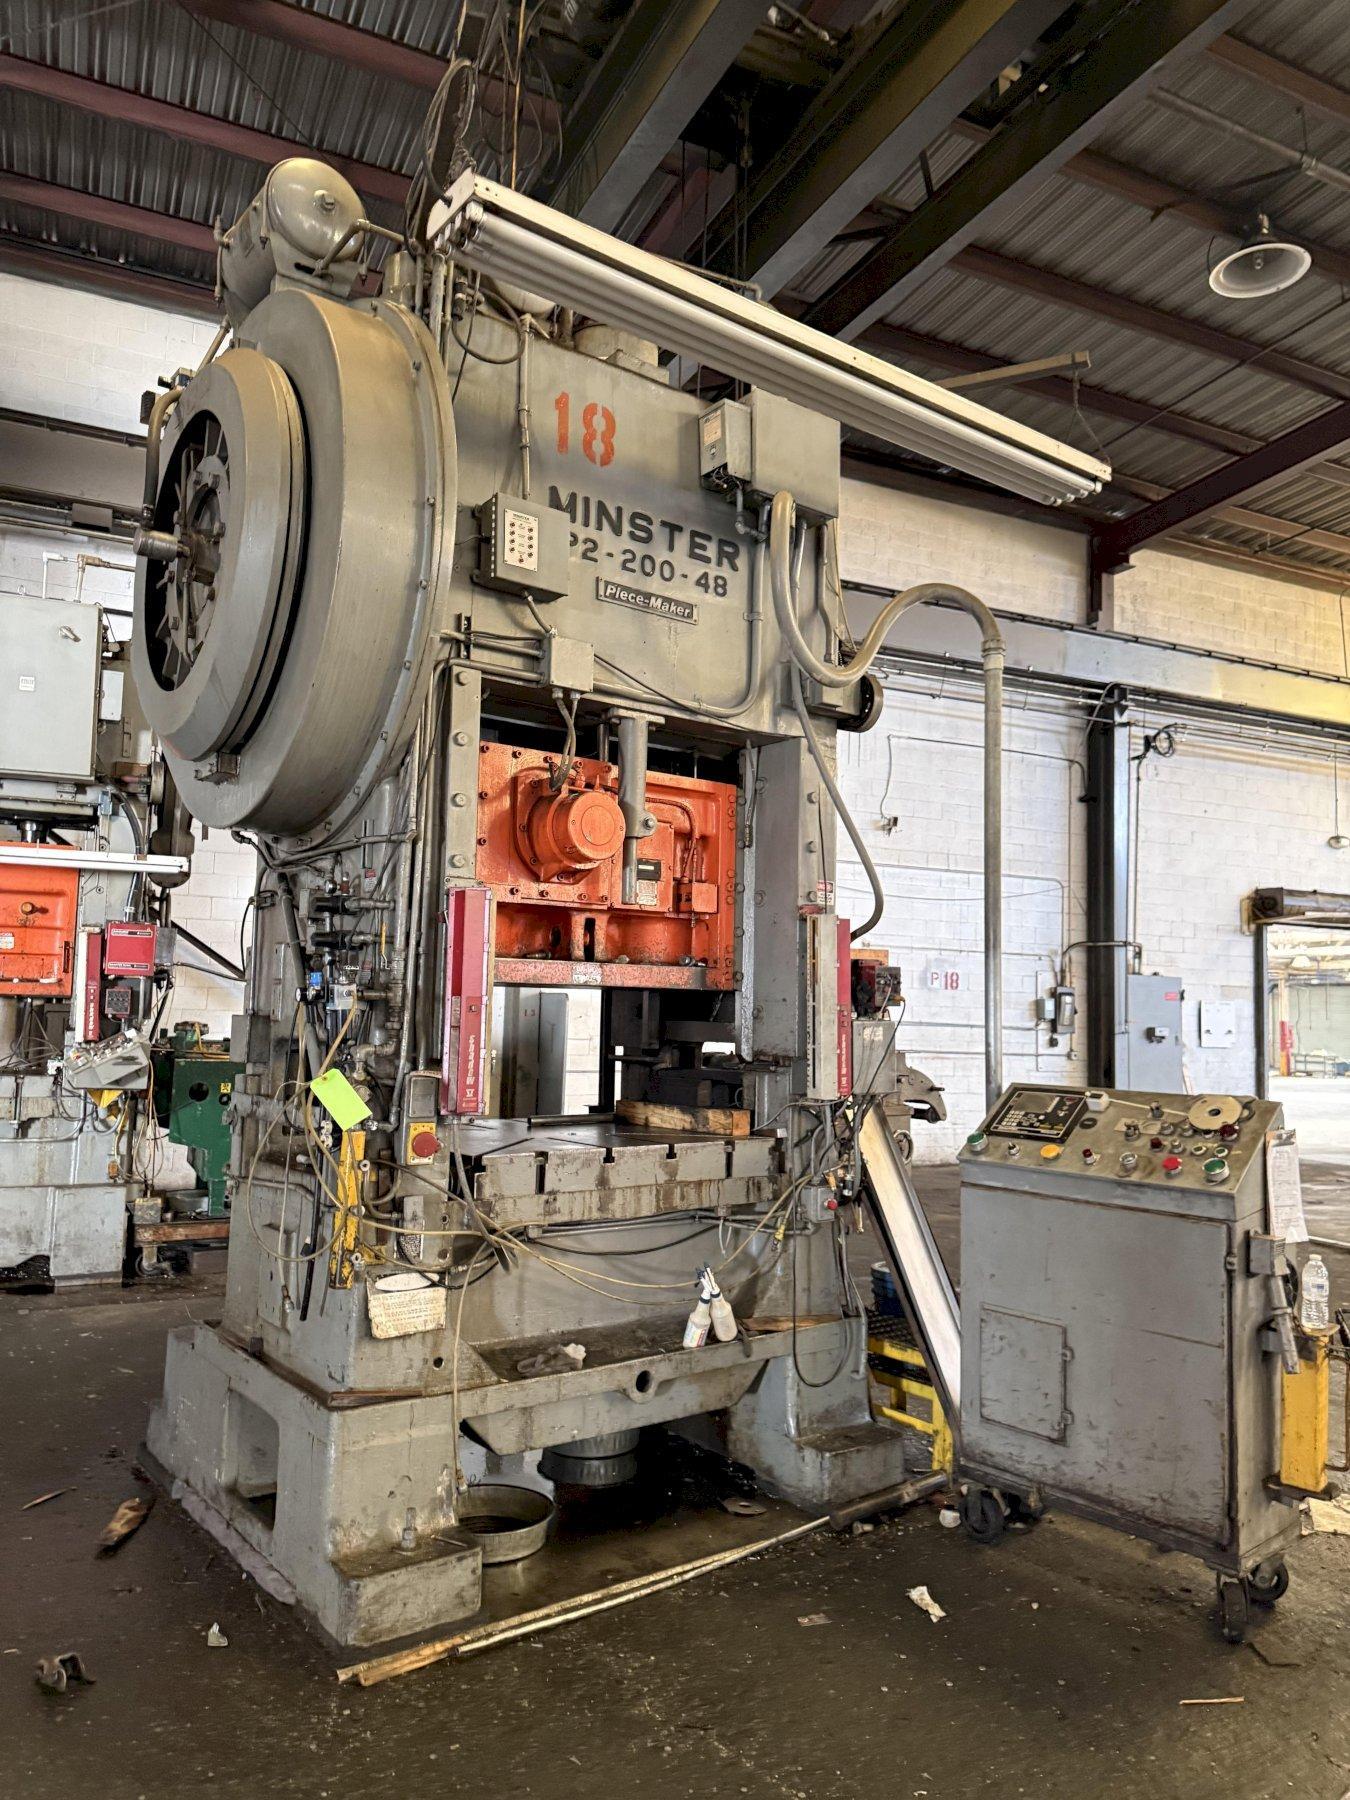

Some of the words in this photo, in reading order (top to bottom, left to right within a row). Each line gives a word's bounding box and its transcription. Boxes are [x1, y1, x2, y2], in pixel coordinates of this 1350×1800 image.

[554, 391, 616, 467] 18
[549, 485, 740, 571] MINSTER
[605, 584, 690, 618] Piece-Maker
[930, 971, 940, 986] P
[944, 971, 959, 990] 18
